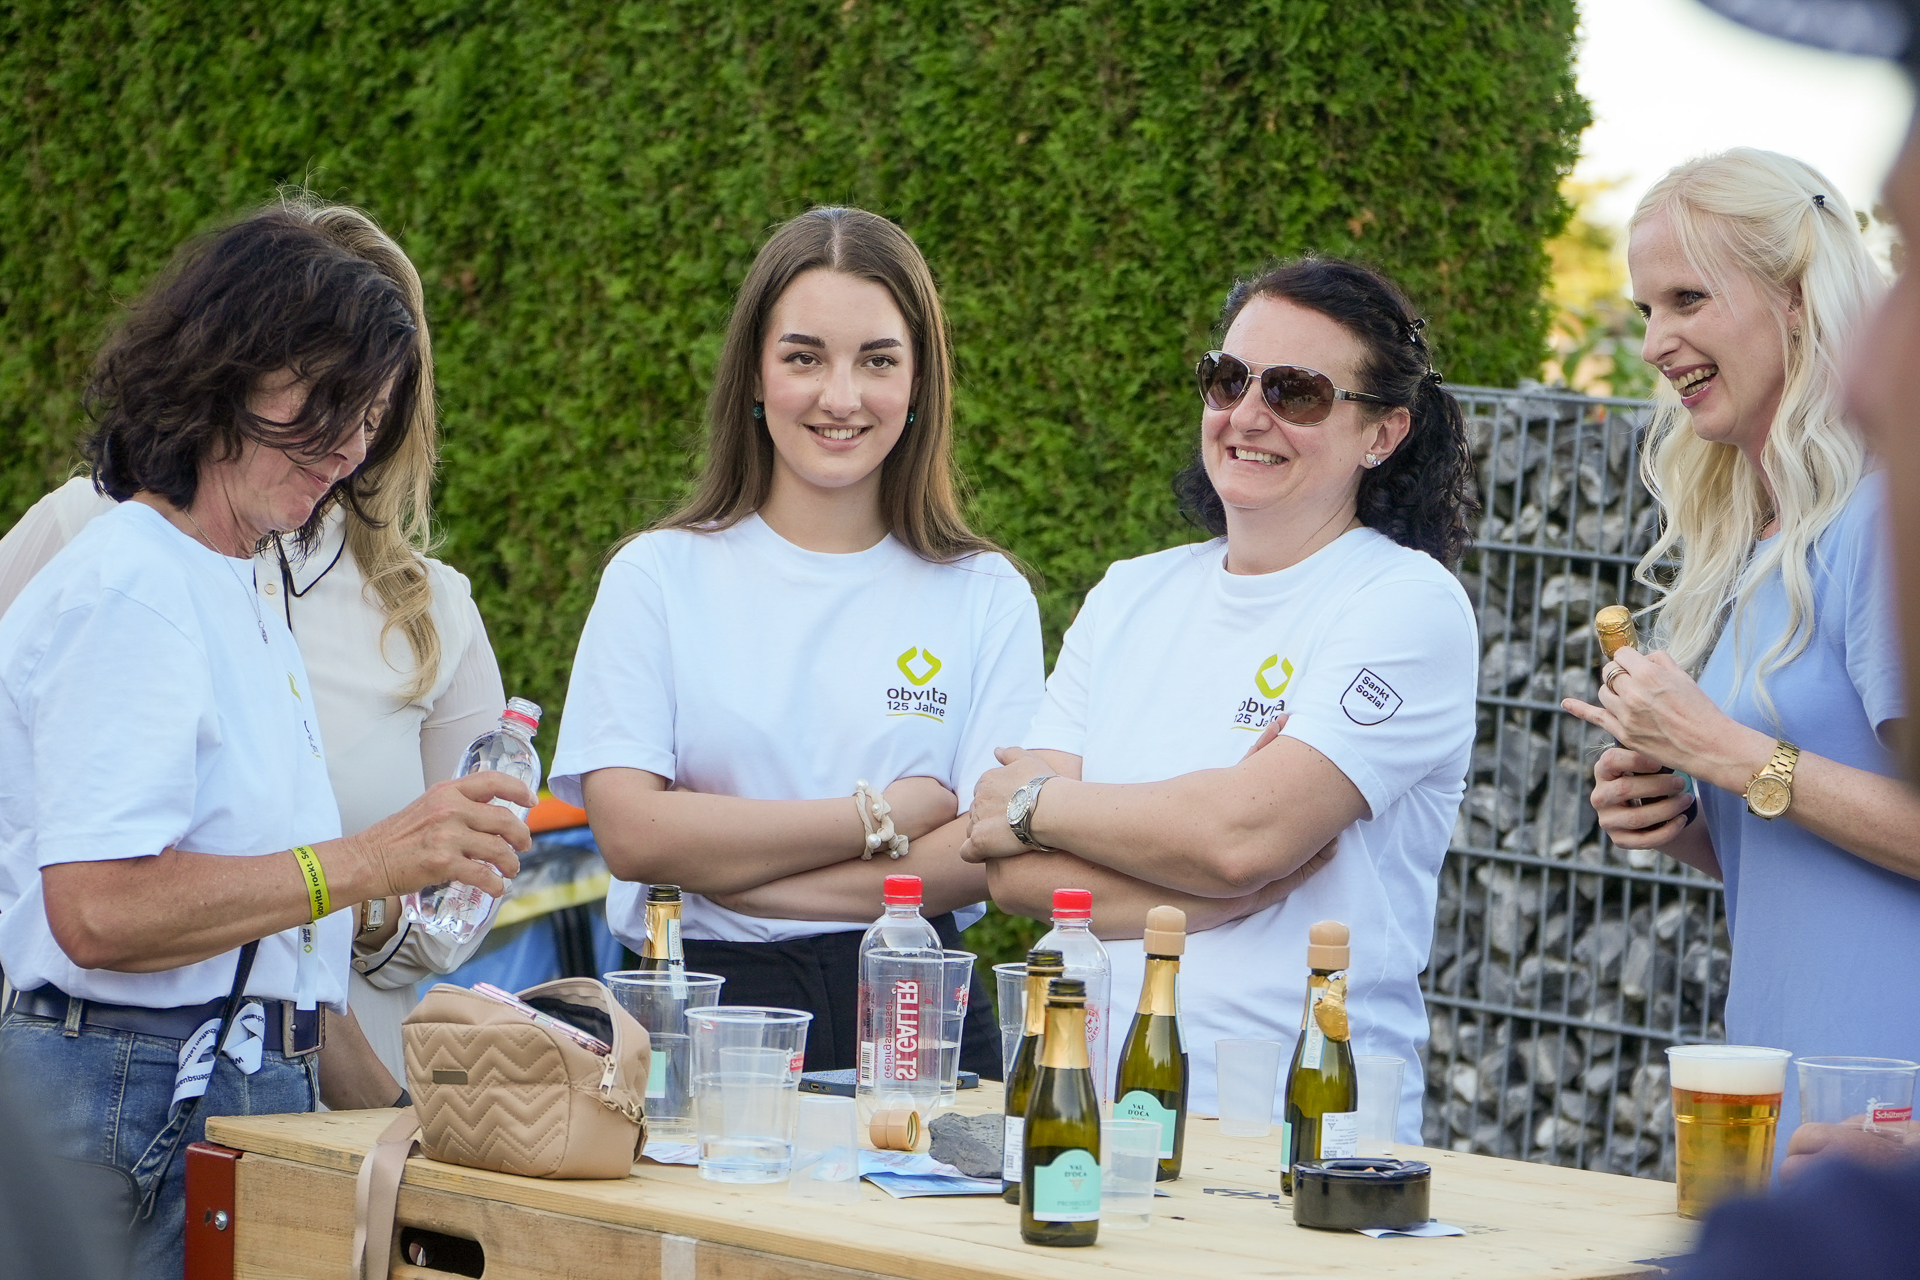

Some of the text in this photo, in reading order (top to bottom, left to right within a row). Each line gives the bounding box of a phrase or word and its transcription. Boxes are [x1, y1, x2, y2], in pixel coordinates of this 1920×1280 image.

[886, 687, 948, 705] obvita
[1355, 684, 1385, 710] Sozial
[1362, 676, 1390, 702] Sankt
[887, 701, 945, 716] 125 Jahre
[306, 860, 320, 887] rockt.
[315, 889, 324, 916] obvita
[195, 1028, 217, 1046] chaffen
[1127, 1109, 1150, 1117] D'OCA
